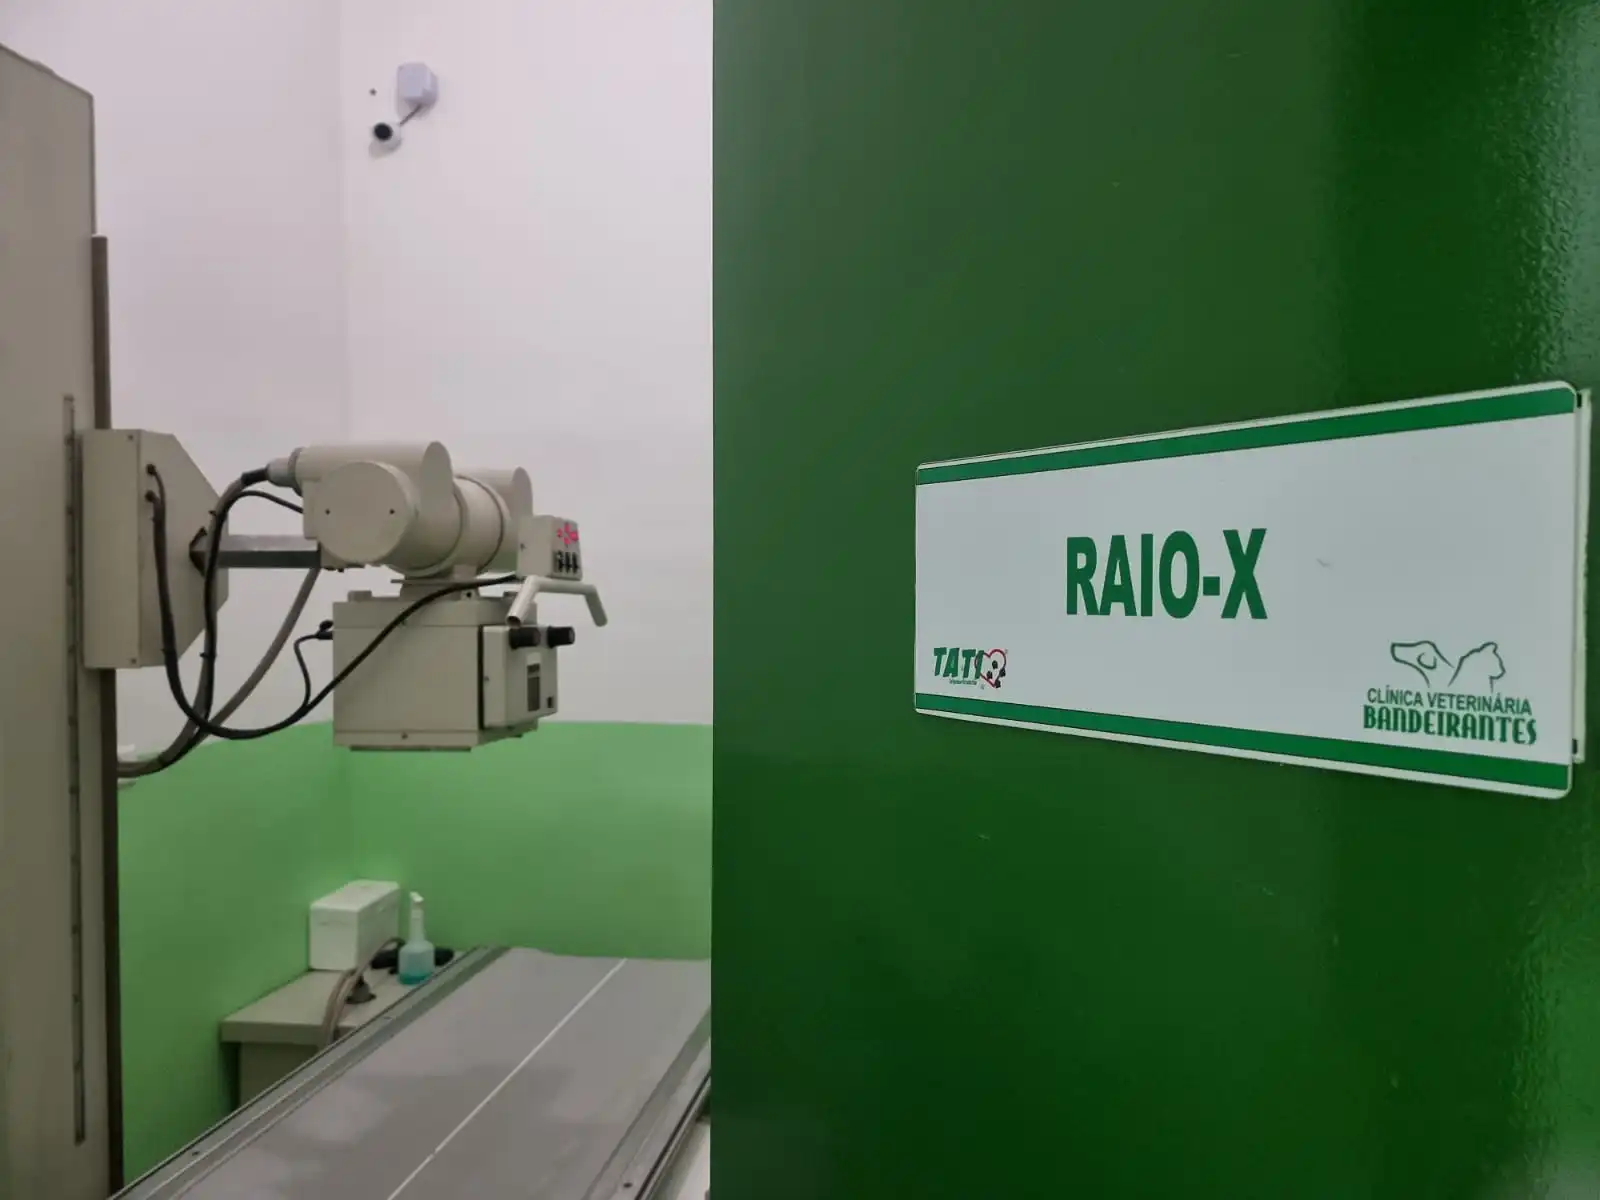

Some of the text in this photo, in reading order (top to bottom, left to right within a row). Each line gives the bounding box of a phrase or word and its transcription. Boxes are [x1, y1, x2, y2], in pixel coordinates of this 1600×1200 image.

[1066, 528, 1268, 619] RAIO-X
[1367, 685, 1533, 716] CLÍNICA VETERINÁRIA
[1363, 704, 1537, 745] BANDEIRANTES
